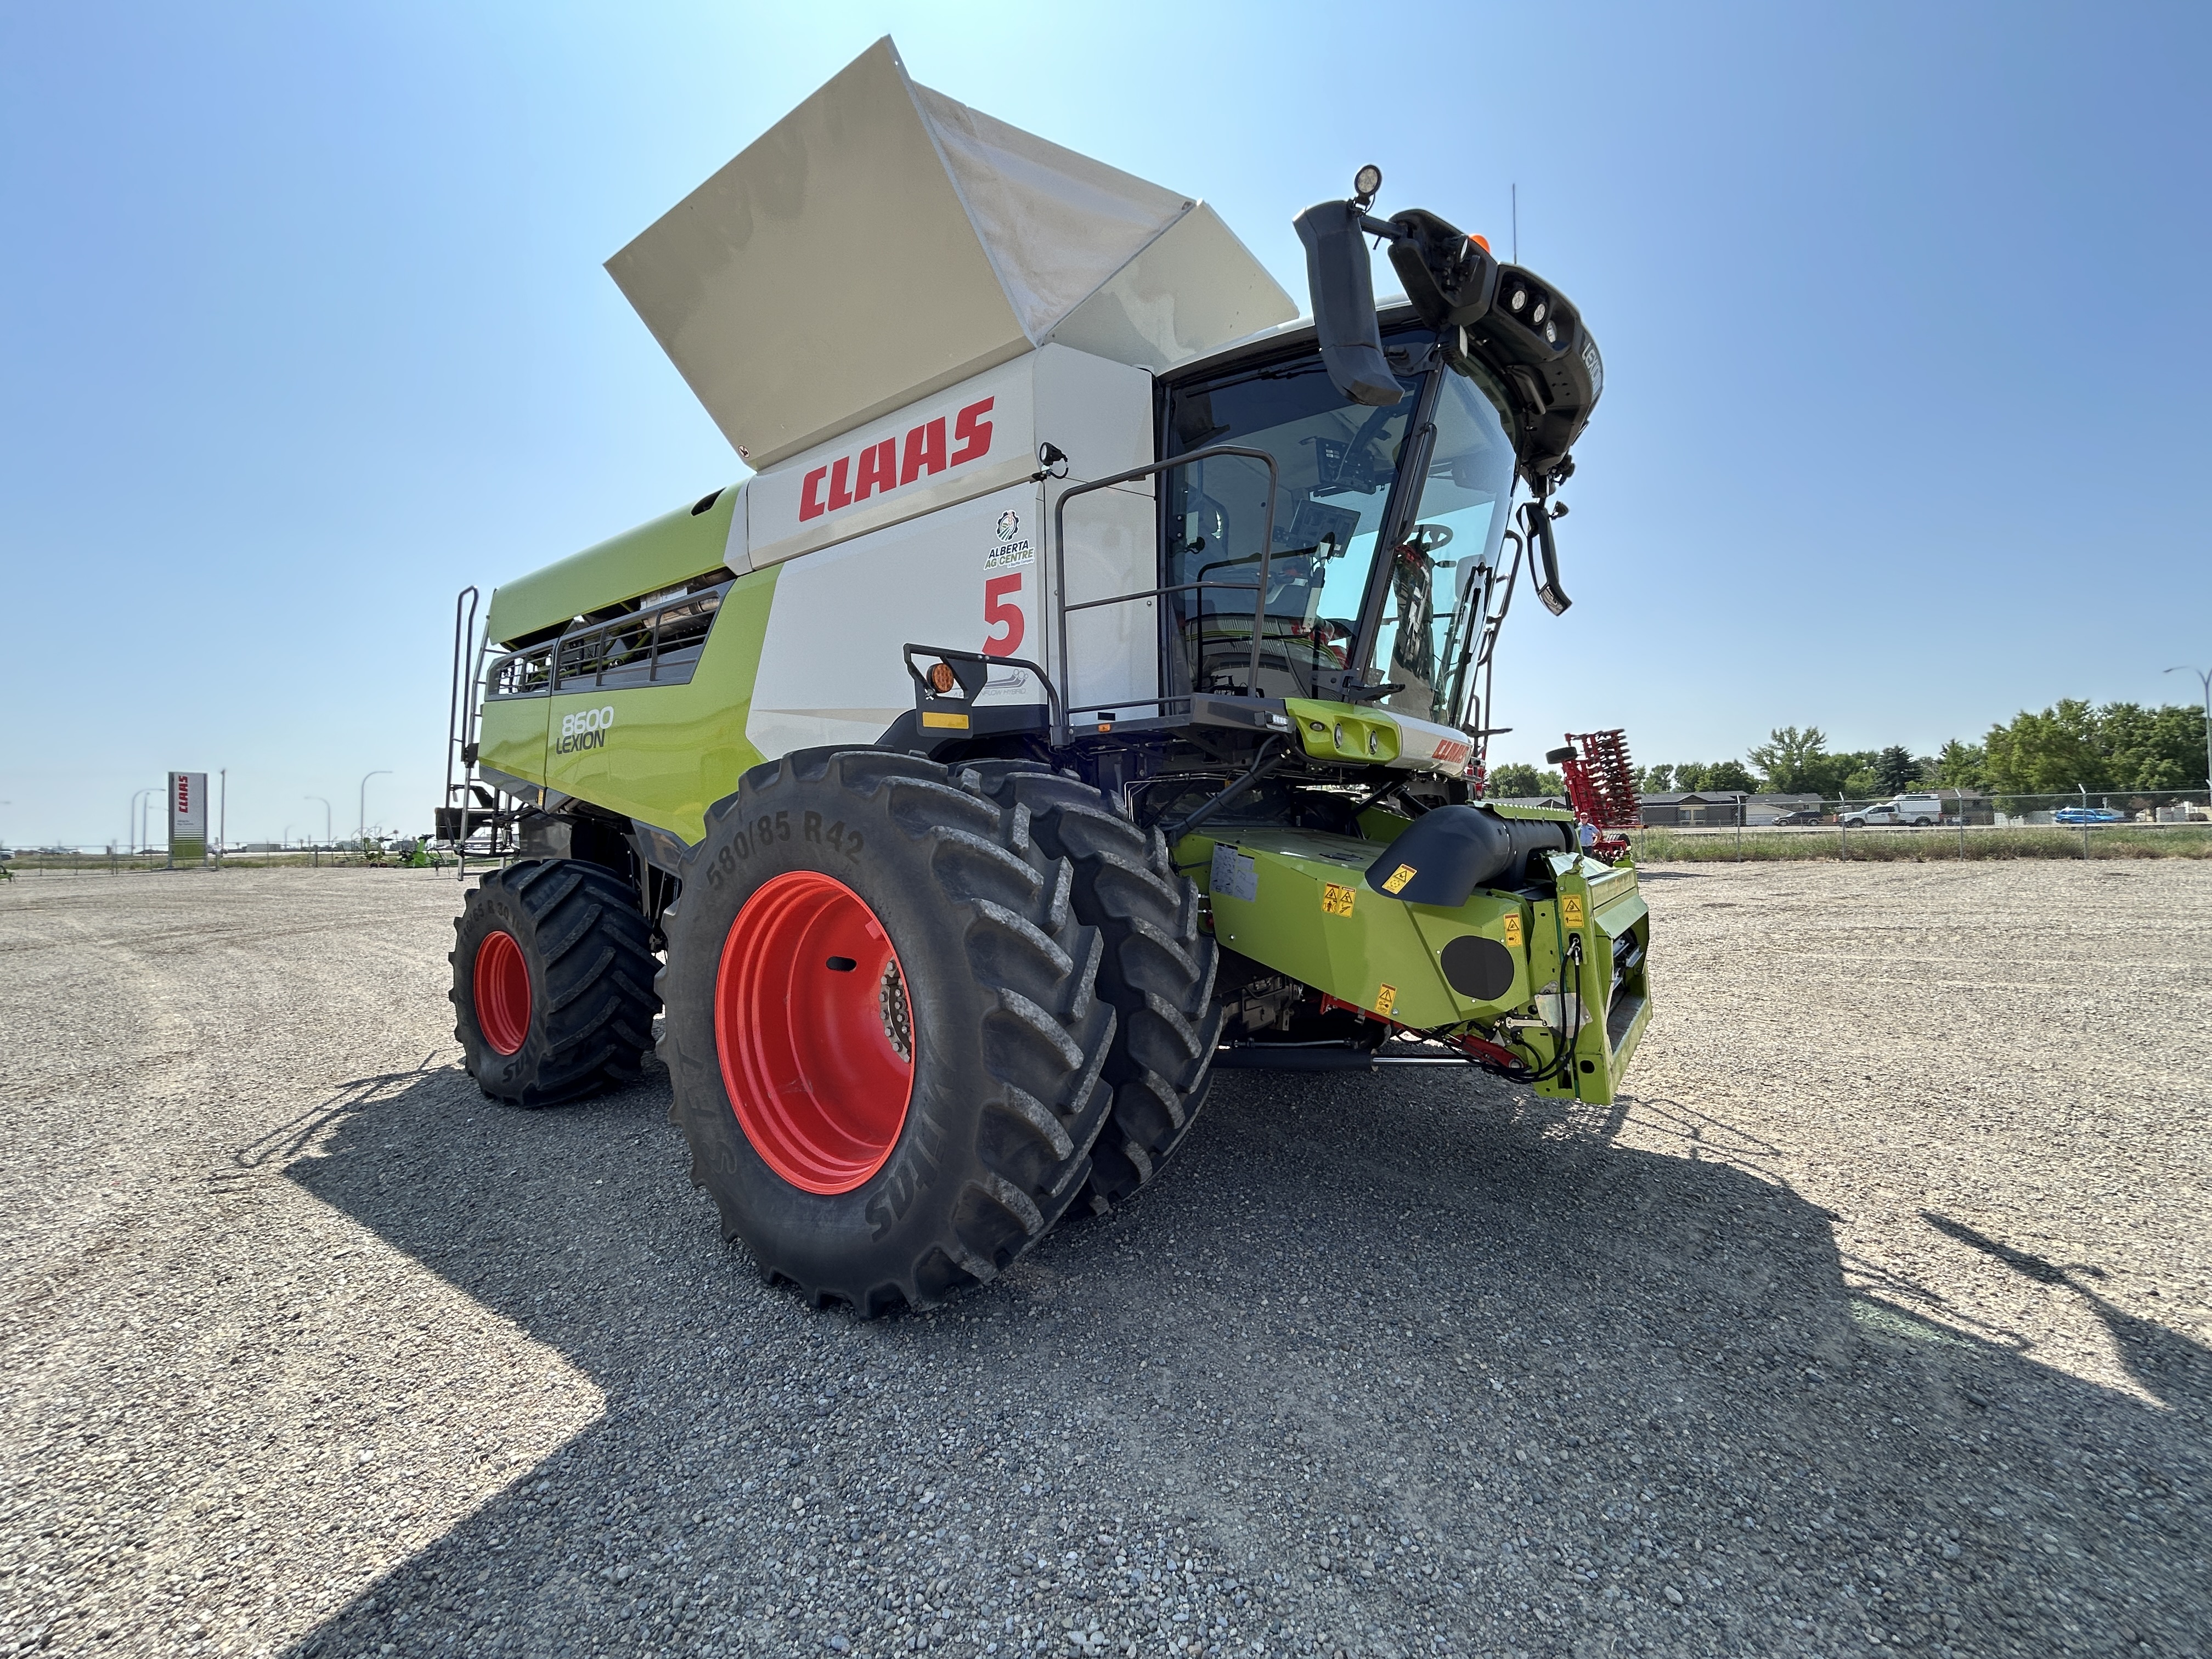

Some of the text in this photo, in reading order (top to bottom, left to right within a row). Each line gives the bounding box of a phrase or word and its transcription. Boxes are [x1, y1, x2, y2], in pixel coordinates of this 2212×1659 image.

[799, 396, 995, 522] CLAAS
[985, 549, 1034, 569] AG CENTRE
[989, 540, 1029, 558] ALBERTA
[982, 572, 1024, 657] 5
[562, 706, 614, 736] 8600
[556, 729, 606, 754] LEXION
[1432, 739, 1470, 764] CLAAS
[178, 775, 188, 813] CLAAS
[706, 810, 864, 891] 580/85 R42
